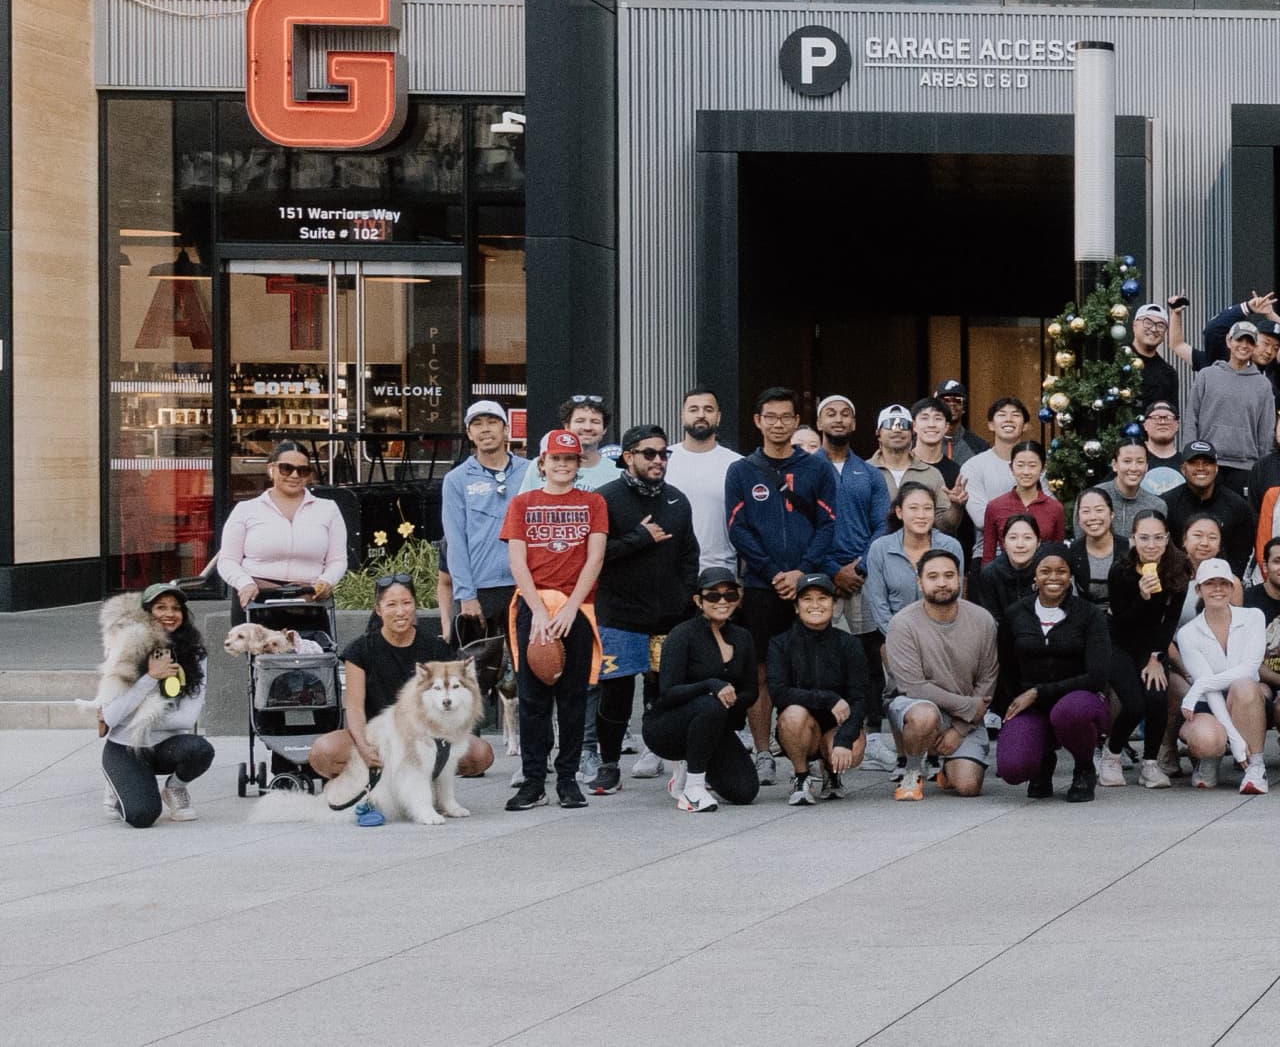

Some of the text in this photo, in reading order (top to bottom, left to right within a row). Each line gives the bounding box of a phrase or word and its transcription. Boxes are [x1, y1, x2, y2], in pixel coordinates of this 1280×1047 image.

[865, 37, 1078, 61] GARAGE ACCESS
[801, 37, 837, 85] P
[919, 72, 1029, 89] AREAS C & D
[278, 207, 401, 223] 151 Warriors Way
[299, 227, 336, 240] Suite
[353, 227, 380, 240] 102
[373, 386, 443, 397] WELCOME
[525, 510, 589, 524] SAN FRANCISCO
[526, 525, 591, 541] 49ERS
